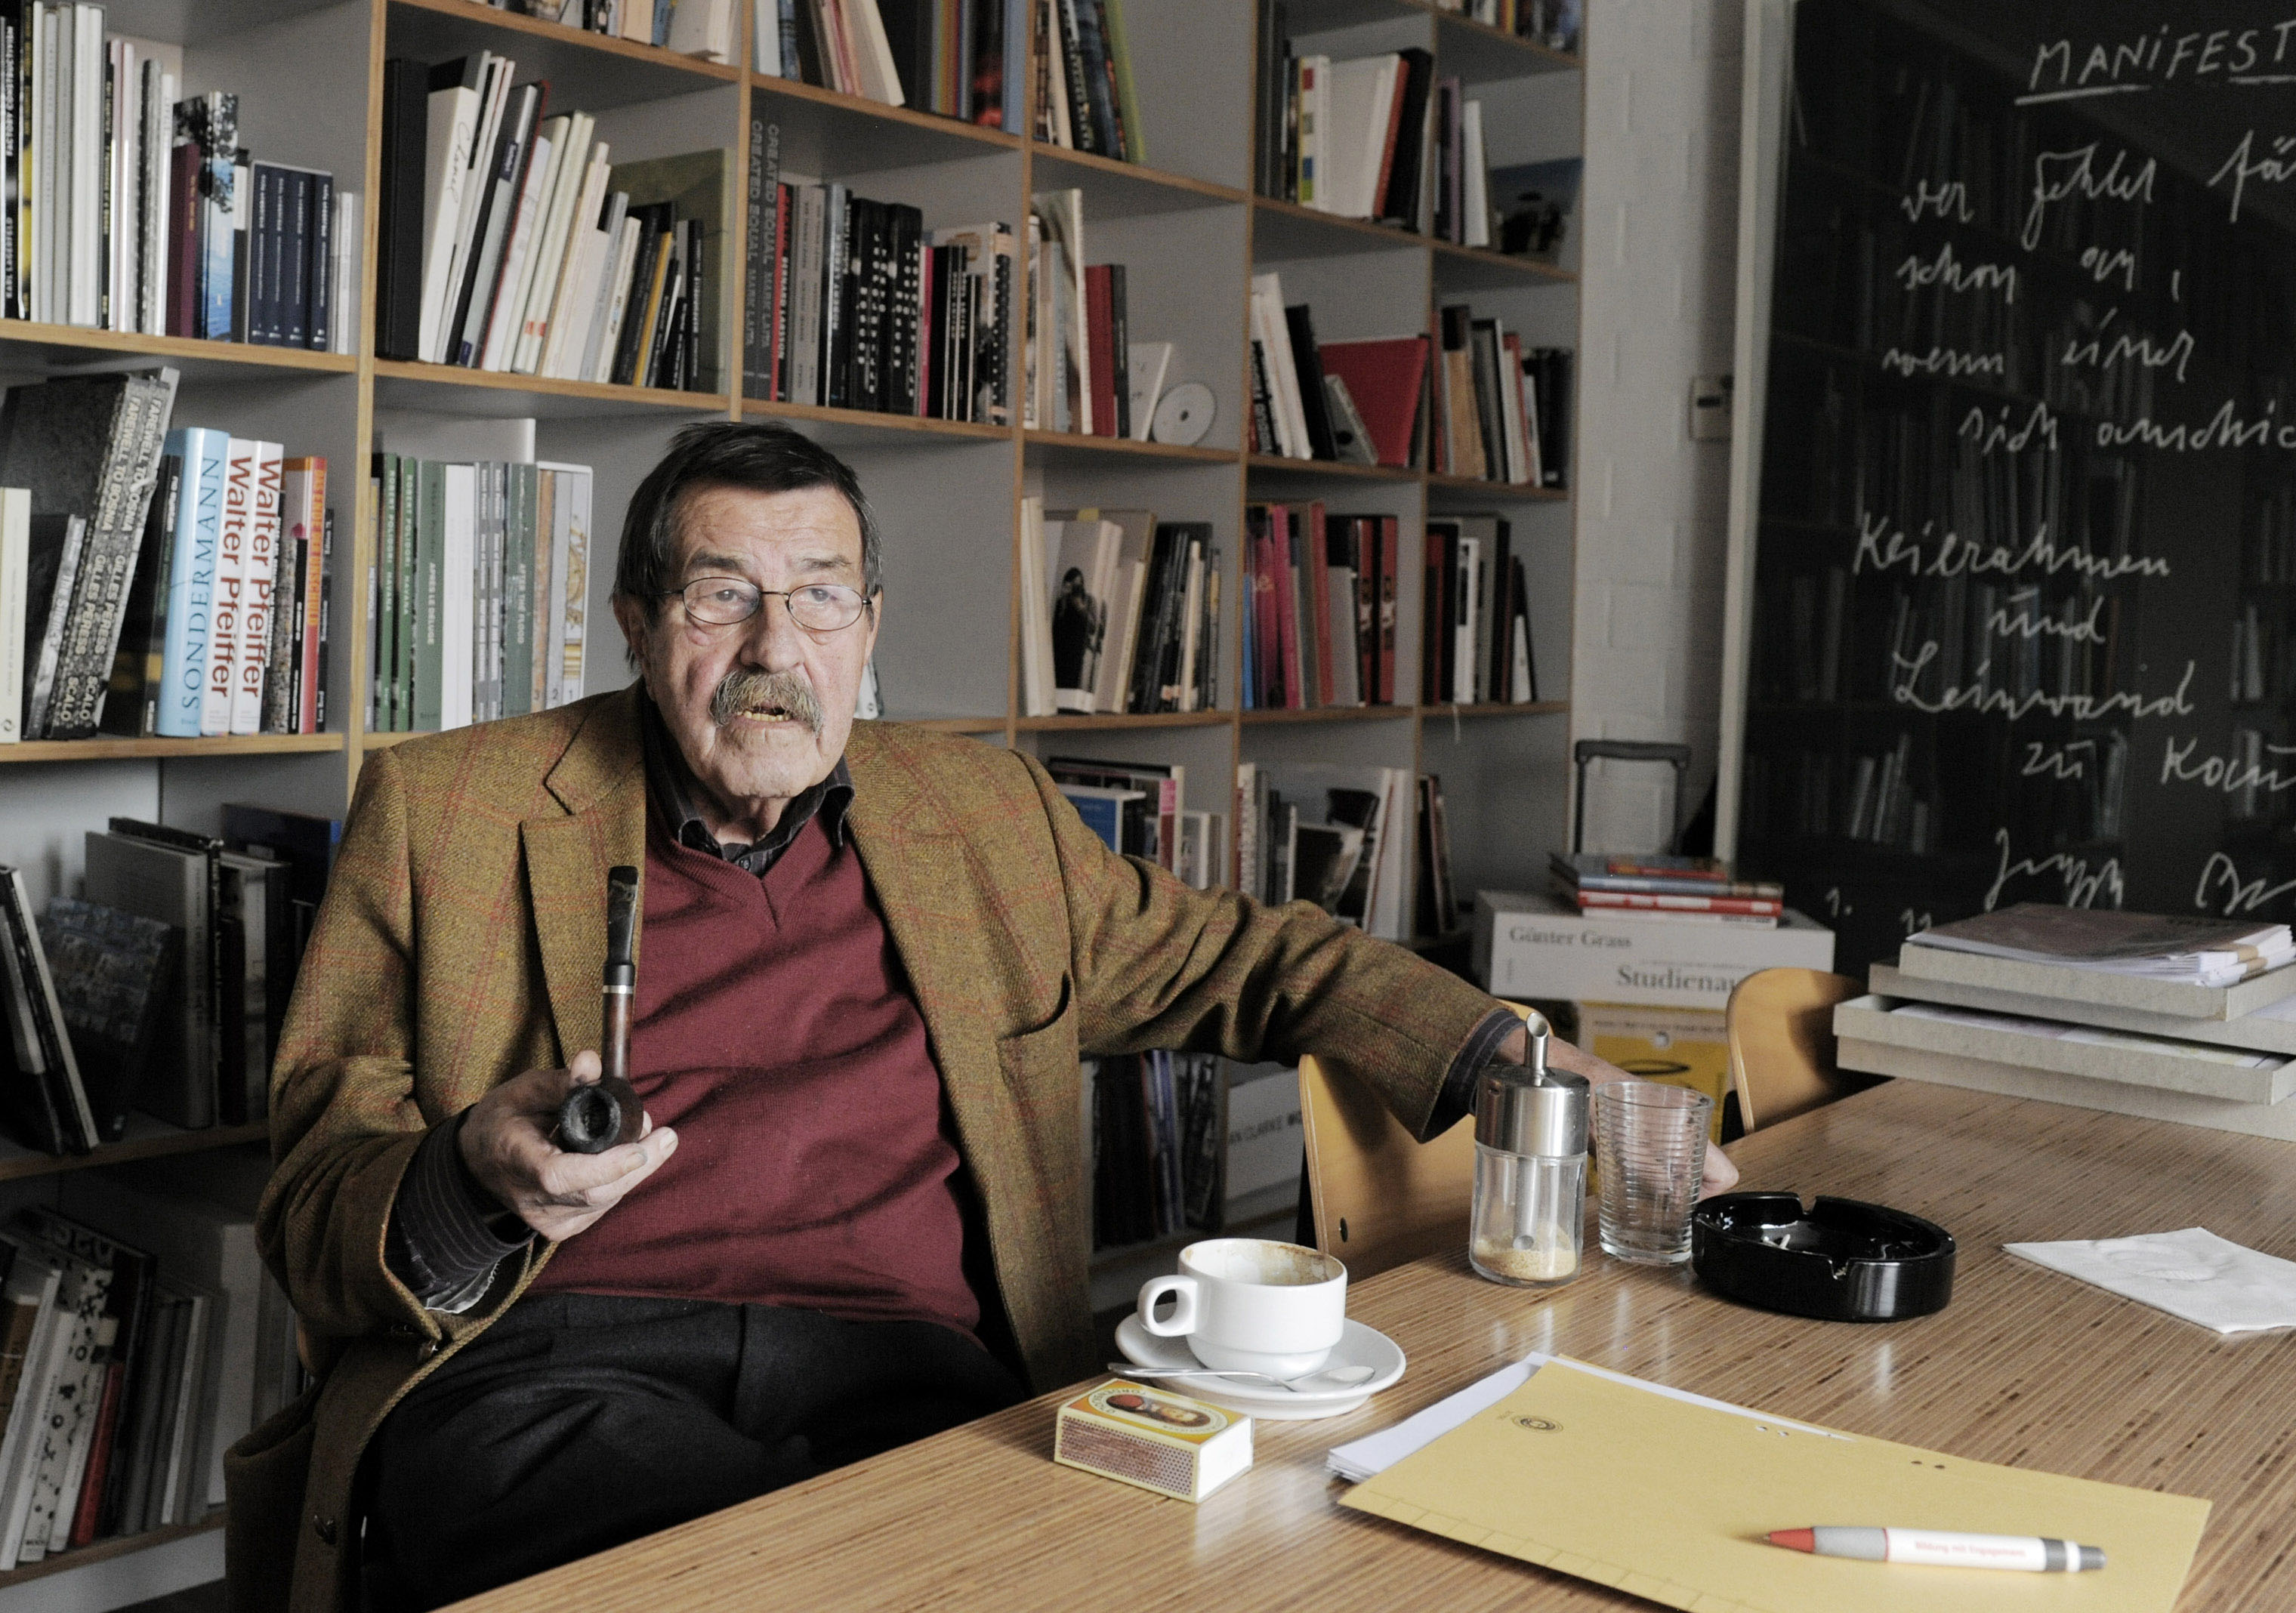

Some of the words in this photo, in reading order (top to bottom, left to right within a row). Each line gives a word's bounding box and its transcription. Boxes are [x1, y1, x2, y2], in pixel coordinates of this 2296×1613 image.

[748, 120, 764, 199] CREATED
[765, 124, 779, 202] CREATED
[747, 203, 761, 262] EQUAL
[762, 207, 776, 264] EQUAL
[119, 397, 141, 461] FAREWELL
[137, 398, 162, 464] FAREWELL
[112, 464, 126, 481] TO
[134, 466, 147, 480] TO
[100, 483, 123, 531] BOSNIA
[222, 456, 252, 566] Walter
[252, 459, 281, 566] Walter
[85, 555, 106, 599] GILLES
[106, 555, 126, 600] GILLES
[182, 457, 220, 710] SONDERMANN
[384, 572, 393, 612] HAVANA
[402, 575, 411, 615] HAVANA
[517, 563, 526, 591] AFTER
[517, 594, 526, 612] THE
[75, 602, 97, 655] PERESS
[94, 602, 117, 655] PERESS
[211, 576, 242, 699] Pfeiffer
[242, 578, 273, 699] Pfeiffer
[517, 613, 526, 645] FLOOD
[60, 676, 80, 721] SCALO
[79, 675, 99, 721] SCALO
[1509, 925, 1575, 947] Günter
[1581, 930, 1632, 948] Grass
